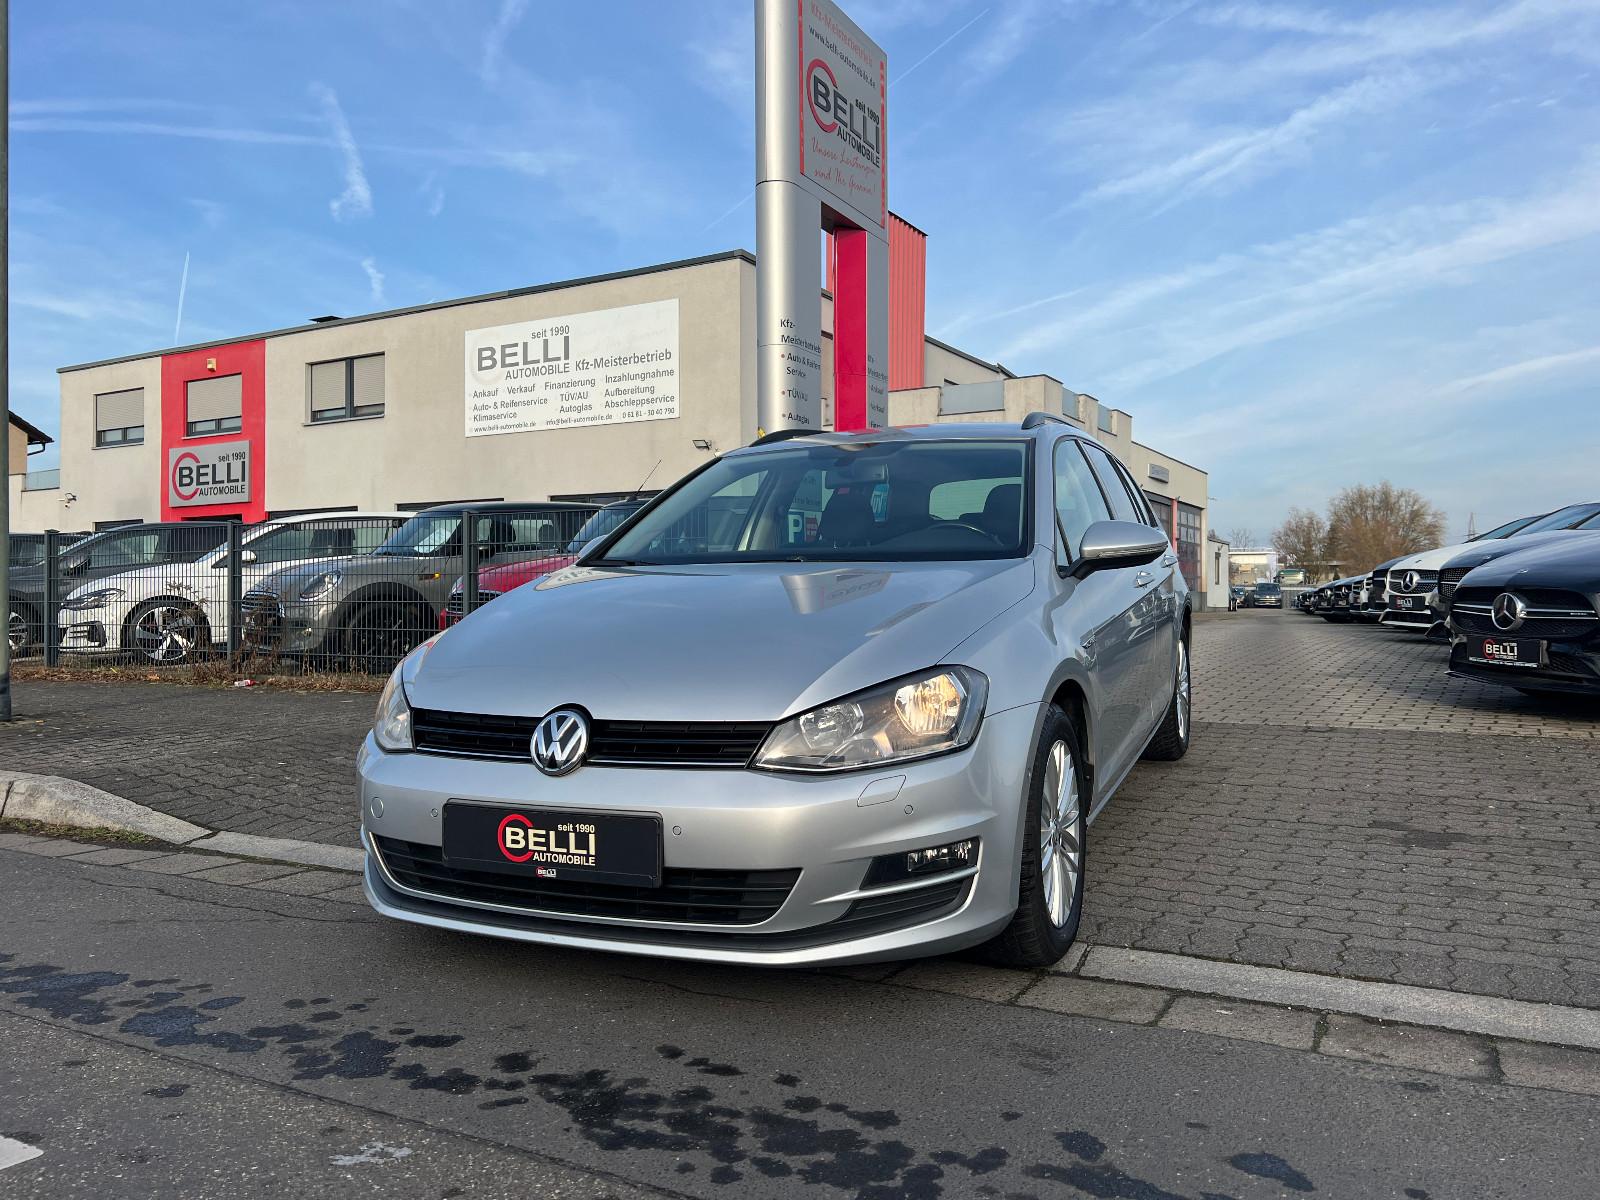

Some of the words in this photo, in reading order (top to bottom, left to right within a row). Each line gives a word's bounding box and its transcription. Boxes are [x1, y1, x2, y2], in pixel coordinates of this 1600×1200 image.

[813, 74, 880, 155] BELLI
[855, 98, 866, 114] seit
[867, 107, 880, 126] 1990
[836, 126, 880, 169] AUTOMOBILE
[531, 329, 547, 340] seit
[549, 325, 570, 337] 1990
[780, 318, 796, 329] Kfz-
[477, 336, 570, 372] BELLI
[780, 334, 821, 354] Meisterbetrieb
[505, 362, 570, 381] AUTOMOBILE
[575, 348, 672, 371] Kfz-Meisterbetrieb
[786, 366, 806, 378] Service
[473, 388, 498, 399] Ankauf
[507, 383, 536, 395] Verkauf
[544, 378, 596, 391] Finanzierung
[605, 368, 675, 384] Inzahlungnahme
[473, 410, 518, 422] Klimaservice
[559, 402, 592, 413] Autoglas
[604, 394, 675, 409] Abschleppservice
[493, 401, 498, 410] &
[500, 396, 548, 409] Reifenservice
[560, 391, 589, 402] TÜV/AU
[604, 385, 655, 398] Aufbereitung
[218, 454, 230, 463] seit
[231, 451, 246, 461] 1990
[178, 460, 246, 487] BELLI
[198, 484, 246, 497] AUTOMOBILE
[1485, 643, 1518, 656] BELLI
[504, 826, 596, 856] BELLI
[557, 823, 574, 833] seit
[575, 823, 596, 834] 1990
[532, 851, 596, 866] AUTOMOBILE
